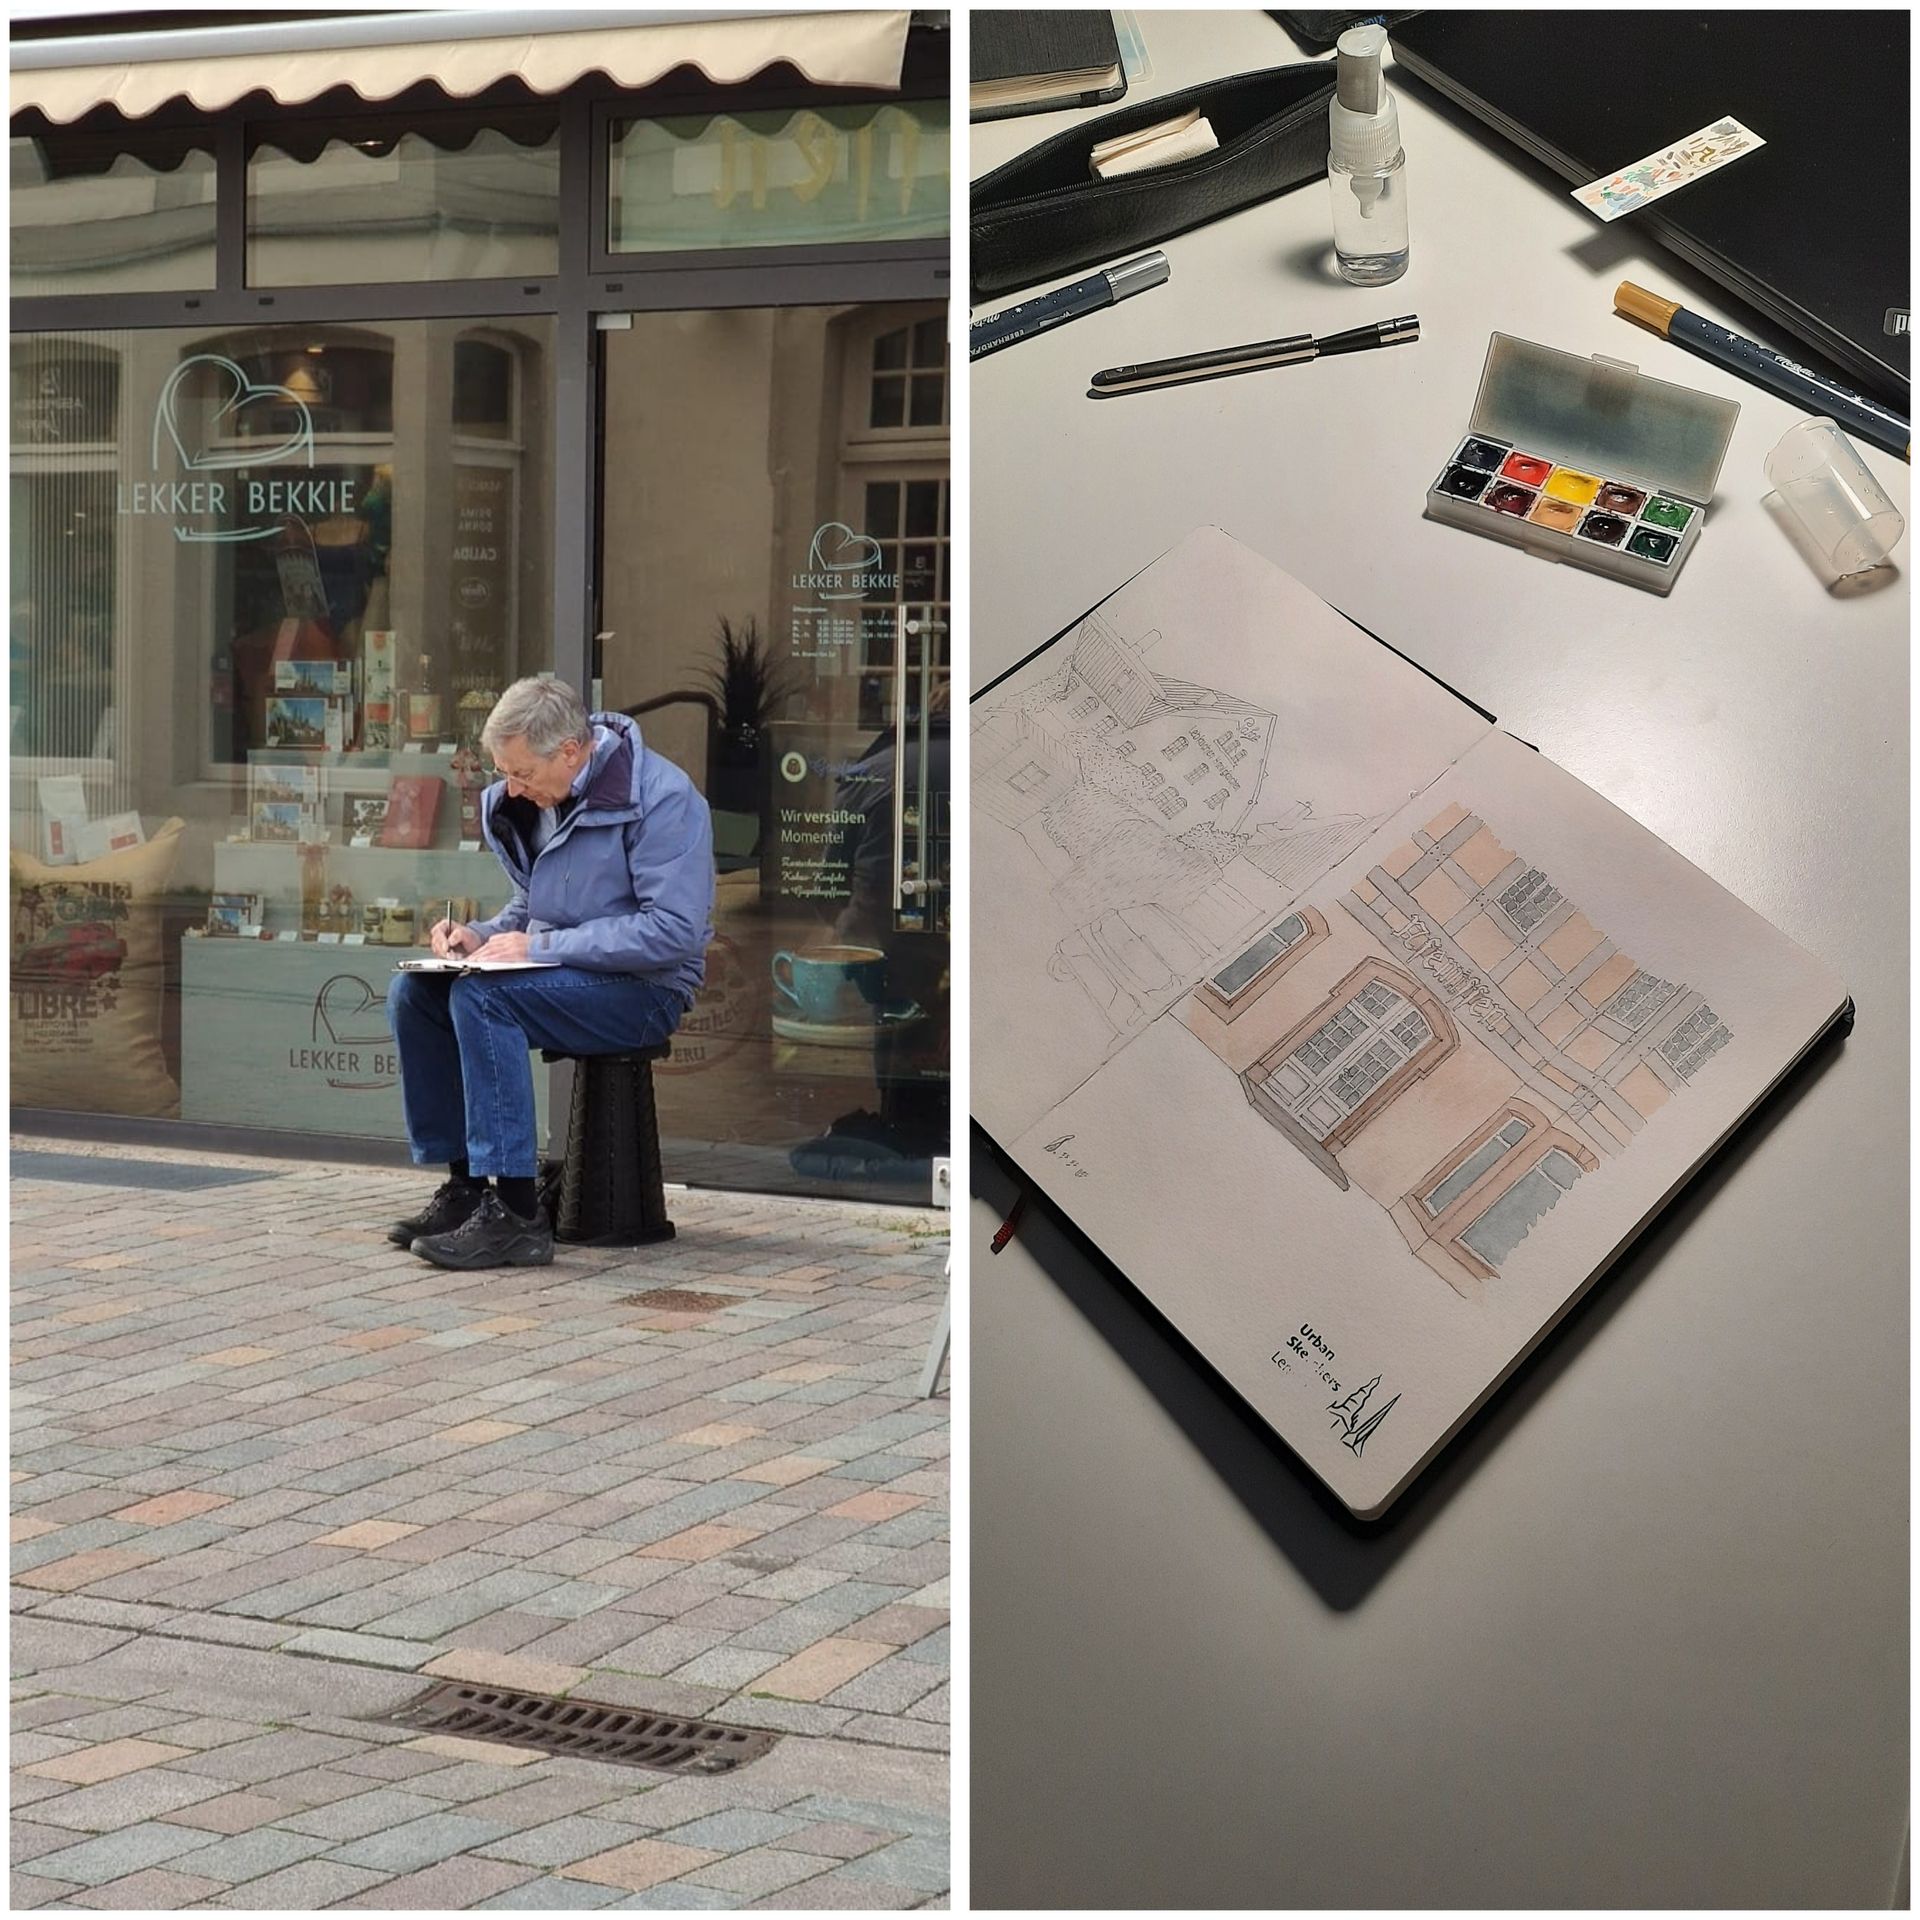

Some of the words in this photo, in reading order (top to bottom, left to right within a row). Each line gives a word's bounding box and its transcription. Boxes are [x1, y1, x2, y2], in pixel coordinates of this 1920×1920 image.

[117, 482, 226, 514] LEKKER
[249, 480, 355, 514] BEKKIE
[792, 574, 843, 588] LEKKER
[852, 574, 900, 588] BEKKIE
[781, 809, 801, 823] Wir
[804, 810, 866, 824] versüßen
[781, 829, 844, 843] Momente!
[290, 1048, 360, 1073] LEKKER
[374, 1053, 401, 1075] BE
[1299, 1323, 1336, 1361] Urban
